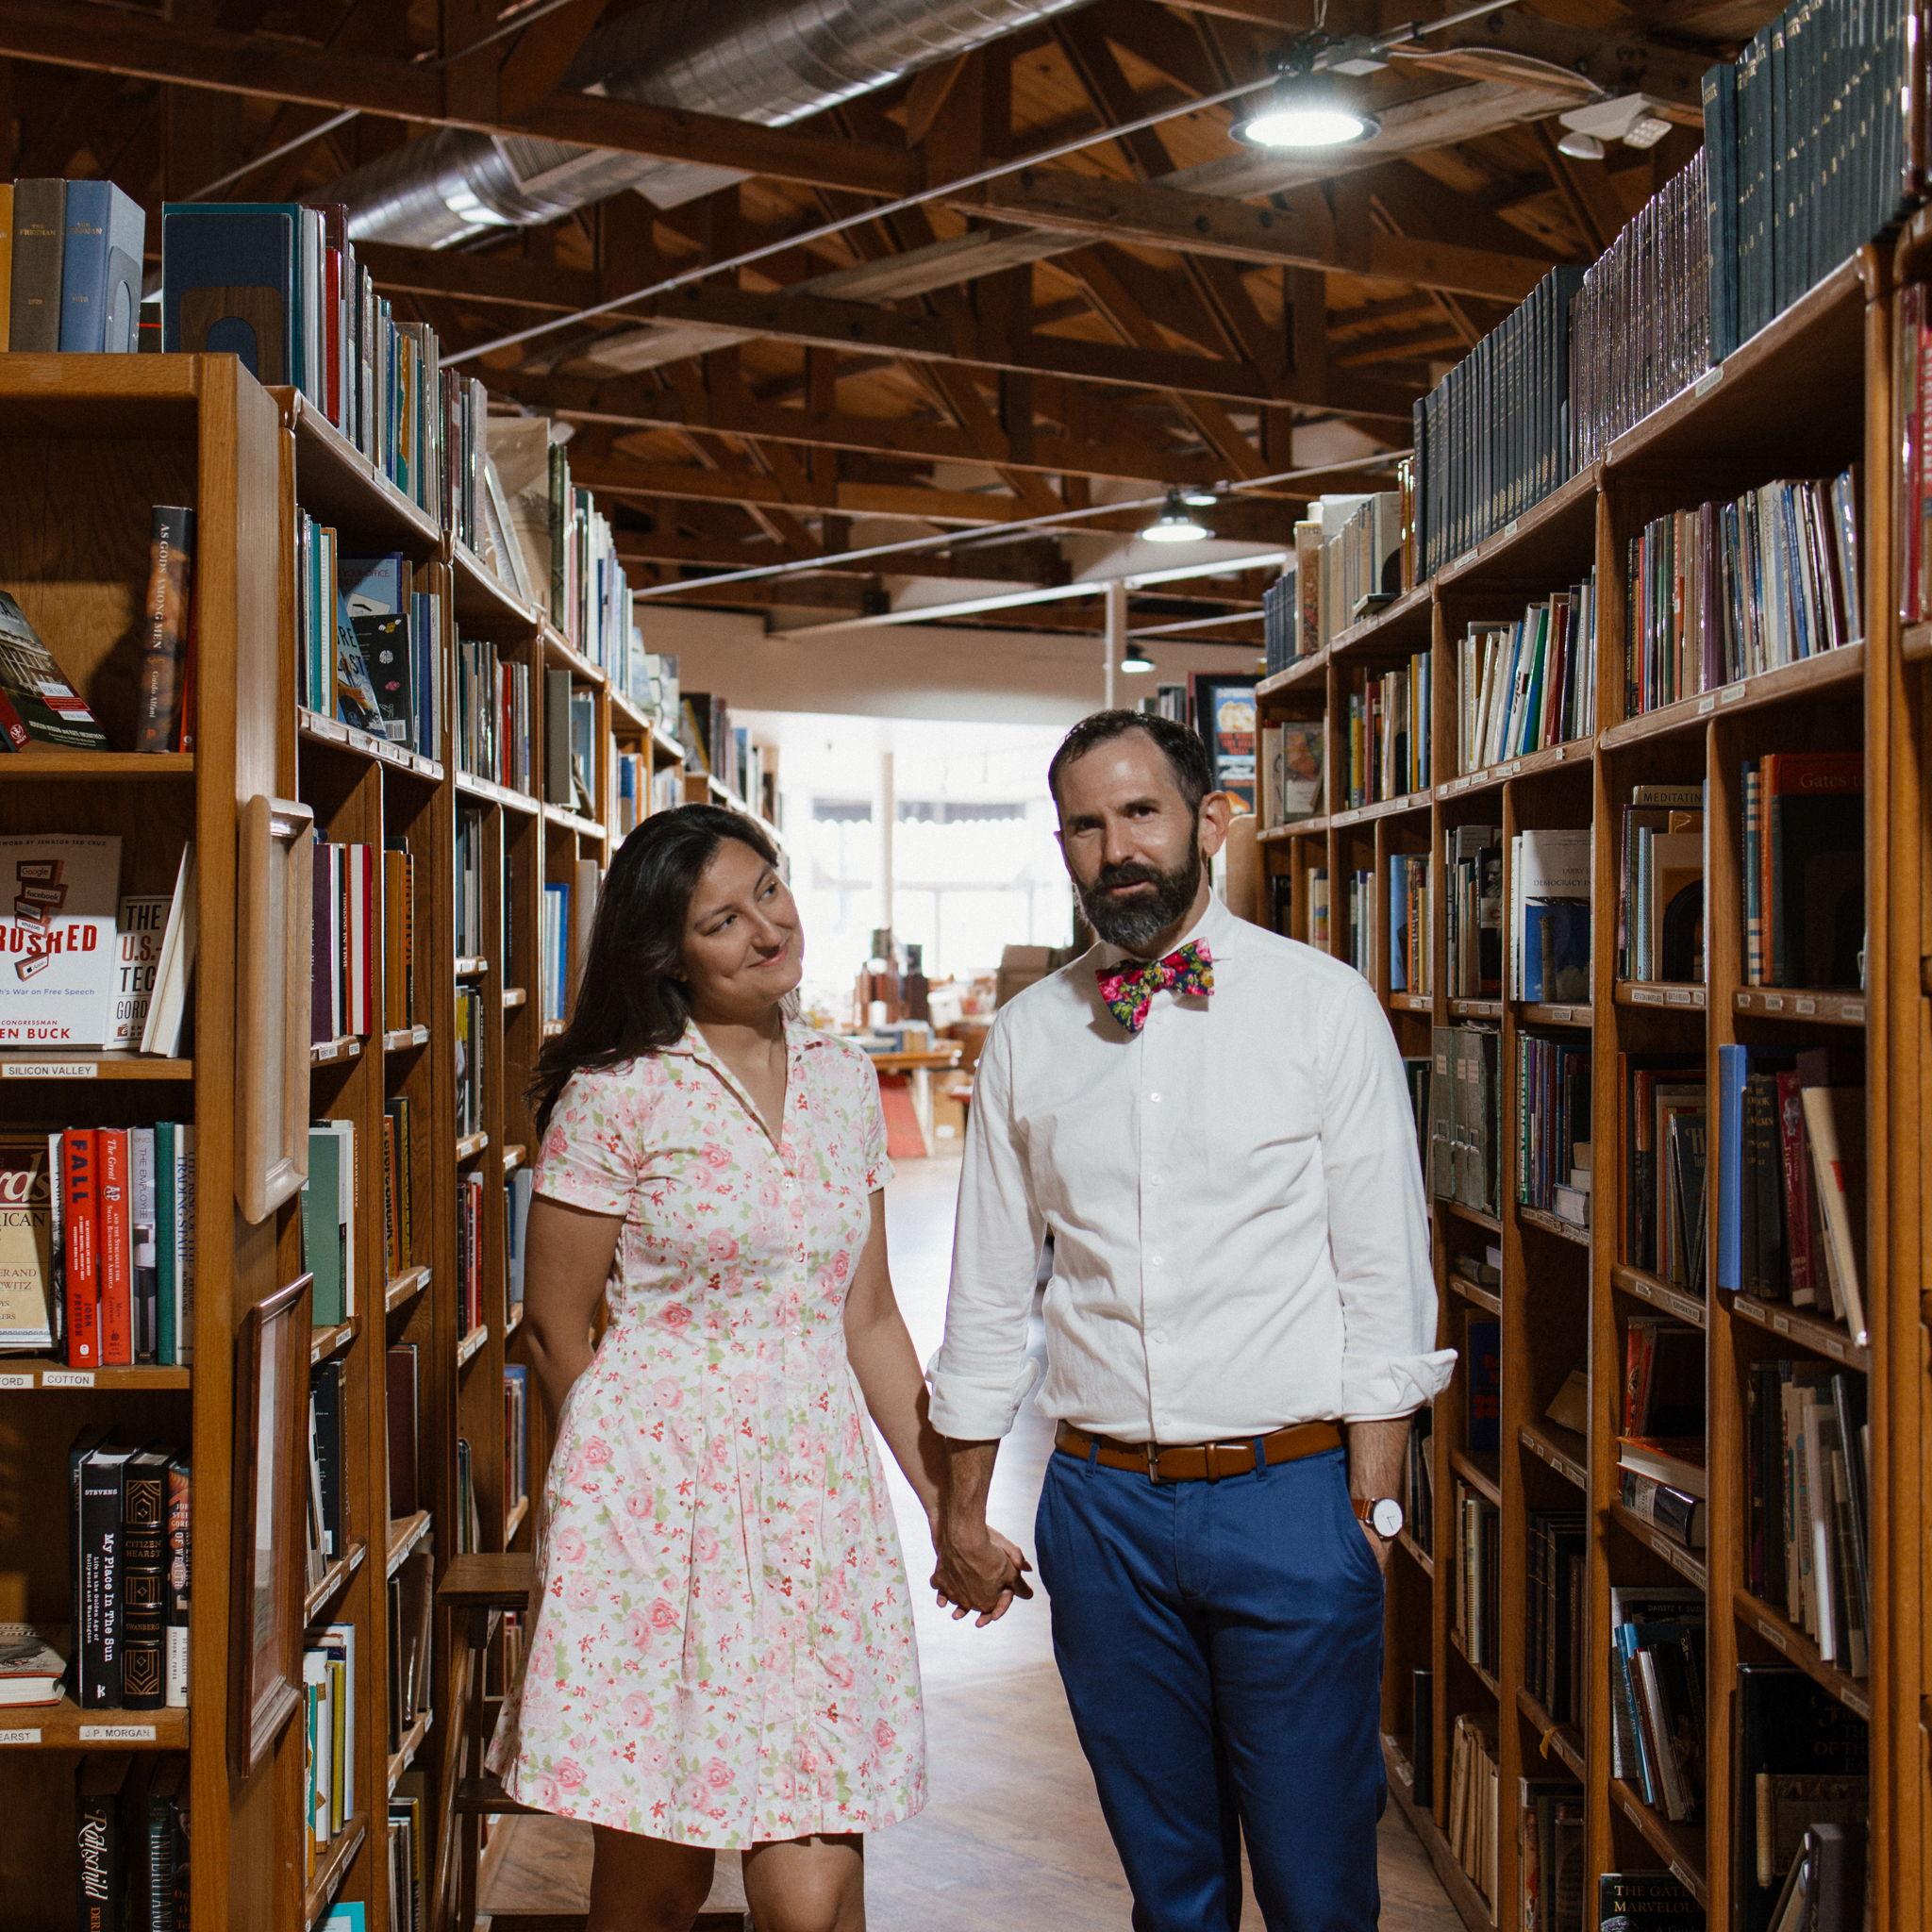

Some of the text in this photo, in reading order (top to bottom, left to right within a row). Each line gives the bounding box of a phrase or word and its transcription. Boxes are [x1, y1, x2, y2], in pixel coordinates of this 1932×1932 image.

[153, 523, 170, 649] AS GODS AMONG MEN
[149, 671, 158, 718] Guido Alfani
[1800, 773, 1851, 789] Gates
[22, 867, 49, 877] Google
[26, 891, 58, 900] facebook
[125, 905, 162, 930] THE
[65, 988, 95, 996] Speech
[27, 1028, 71, 1039] BUCK
[8, 1067, 92, 1075] SILICON VALLEY
[108, 1139, 117, 1156] The
[72, 1140, 89, 1204] FALL
[108, 1157, 117, 1180] Great
[139, 1169, 148, 1219] EMPLOYEE
[176, 1155, 188, 1262] TRADING STATE
[0, 1212, 45, 1227] ICAN
[11, 1269, 37, 1277] AND
[75, 1293, 83, 1337] PRESTON
[2, 1377, 24, 1386] ORD
[47, 1375, 90, 1385] COTTON
[125, 1541, 162, 1549] CITIZEN
[175, 1532, 184, 1589] OF WEALTH
[103, 1533, 114, 1662] My Place In The Sun
[85, 1728, 150, 1738] J.P. MORGAN
[78, 1808, 108, 1901] Rothschild
[1614, 1885, 1645, 1896] THE
